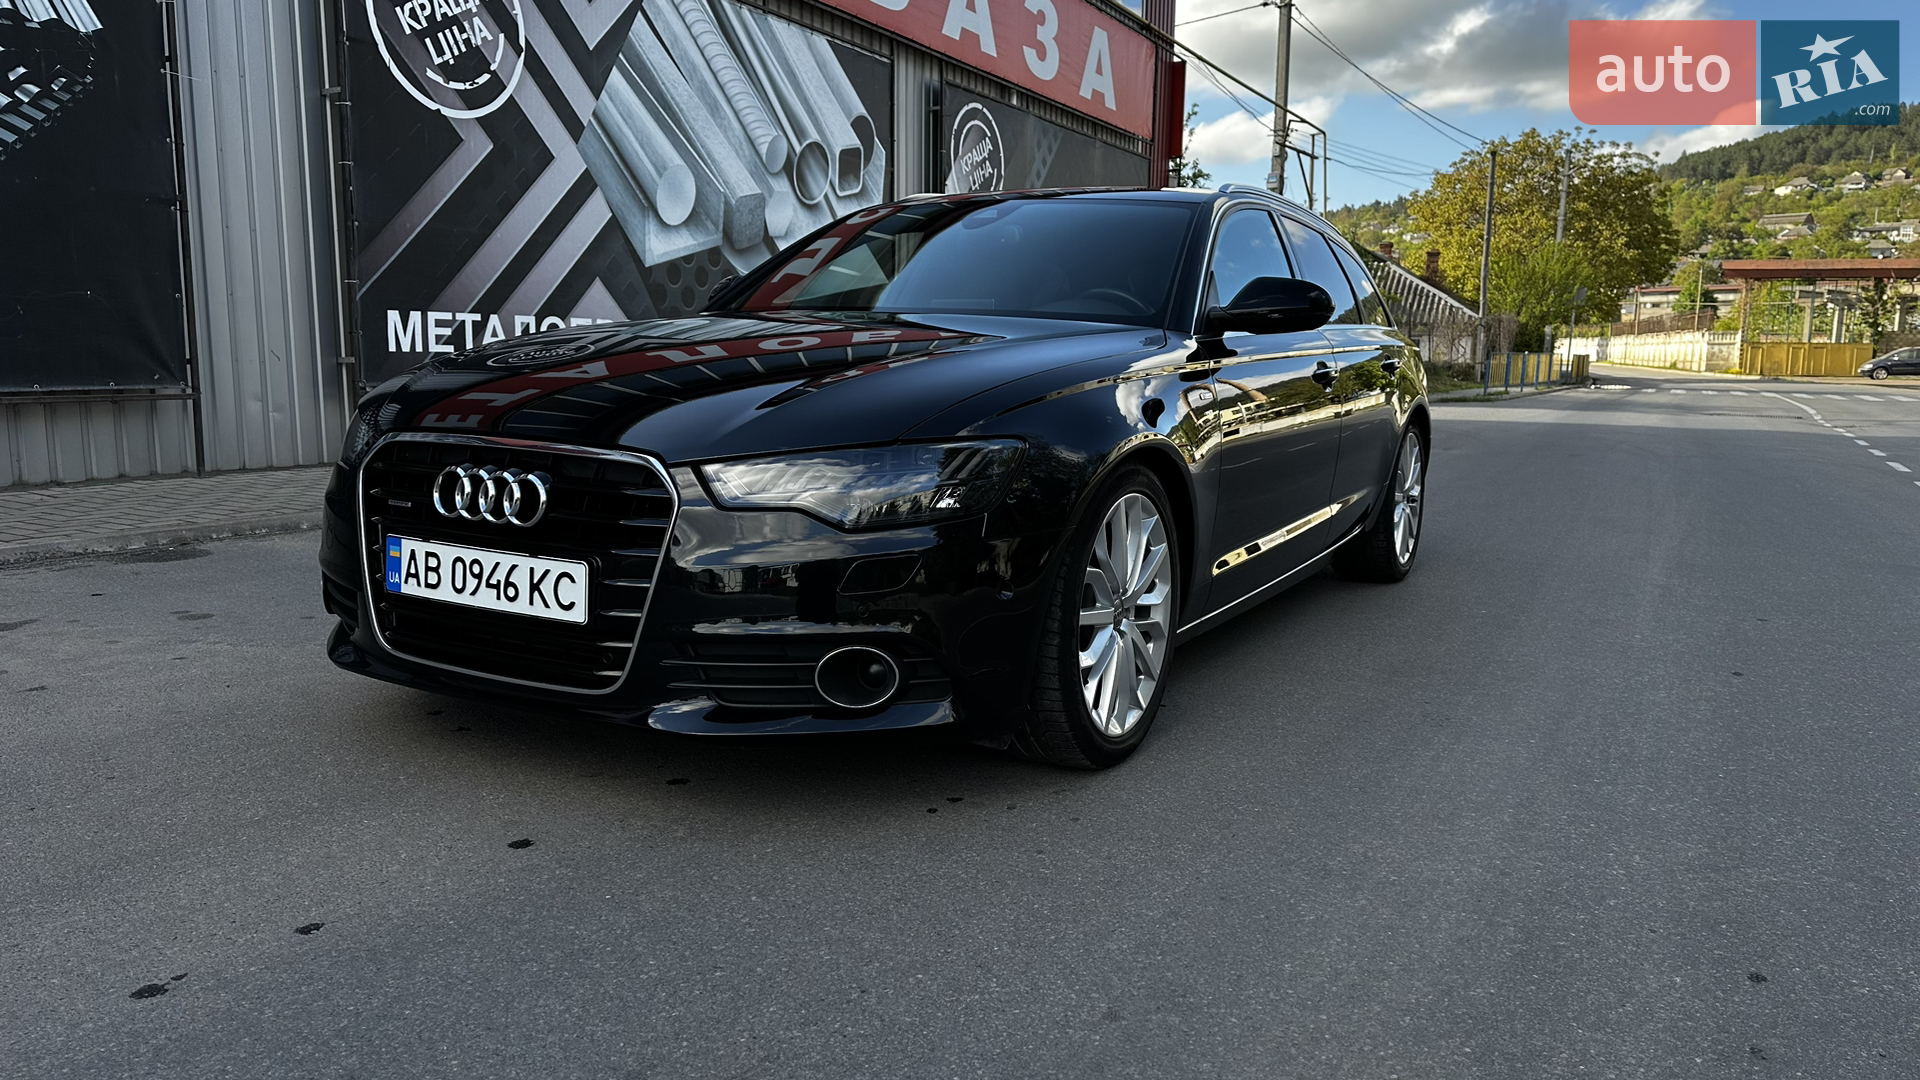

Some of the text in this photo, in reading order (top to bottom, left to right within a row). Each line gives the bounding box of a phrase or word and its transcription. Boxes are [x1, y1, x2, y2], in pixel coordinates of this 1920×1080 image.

[424, 16, 494, 65] ЦІНА
[869, 0, 1117, 111] АЗА
[960, 136, 993, 175] КРАЩА
[969, 160, 993, 191] ЦІНА
[388, 571, 401, 584] UA
[404, 548, 577, 611] AB 0946 KC
